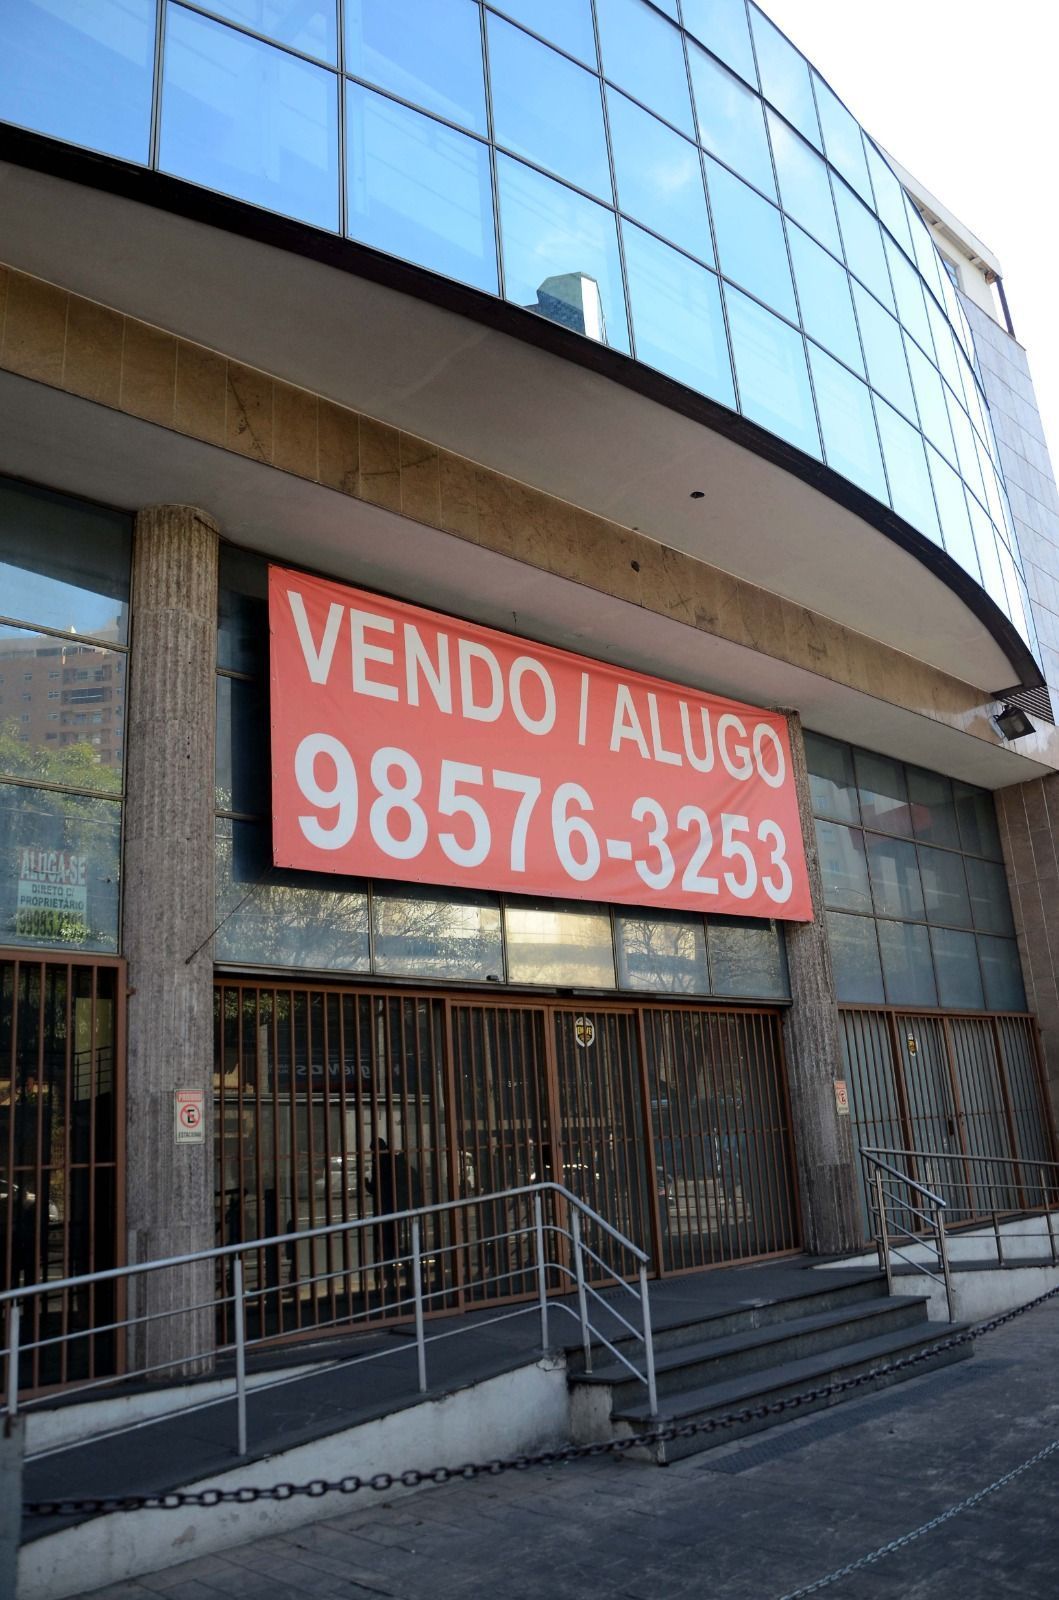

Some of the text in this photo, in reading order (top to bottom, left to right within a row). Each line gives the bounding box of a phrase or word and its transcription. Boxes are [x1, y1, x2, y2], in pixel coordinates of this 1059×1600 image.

[286, 590, 557, 736] VENDO
[609, 683, 786, 789] ALUGO
[19, 849, 86, 885] ALUGA-SE
[294, 732, 793, 904] 98576-3253
[32, 884, 63, 896] DIRETO
